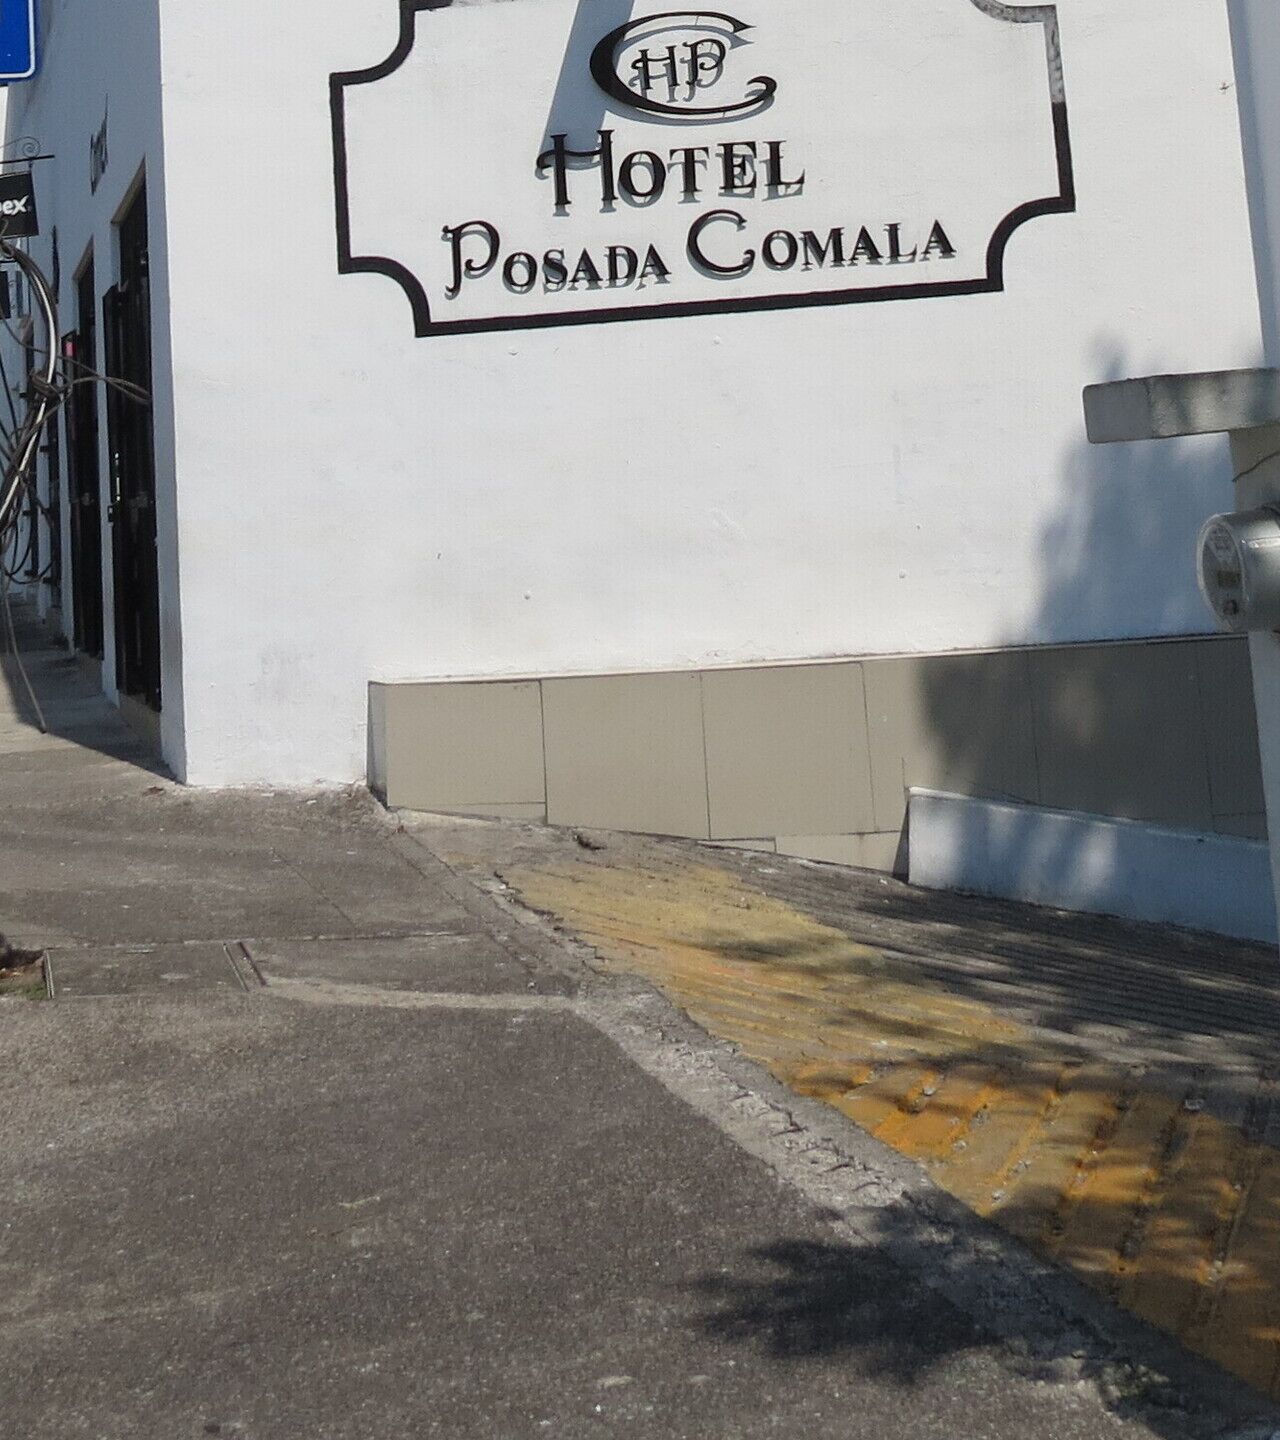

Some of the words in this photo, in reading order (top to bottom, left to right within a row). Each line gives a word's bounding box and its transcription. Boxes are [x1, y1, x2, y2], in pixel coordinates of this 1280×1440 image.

[536, 129, 805, 208] HOTEL
[441, 220, 672, 295] POSADA
[686, 209, 956, 272] COMALA
